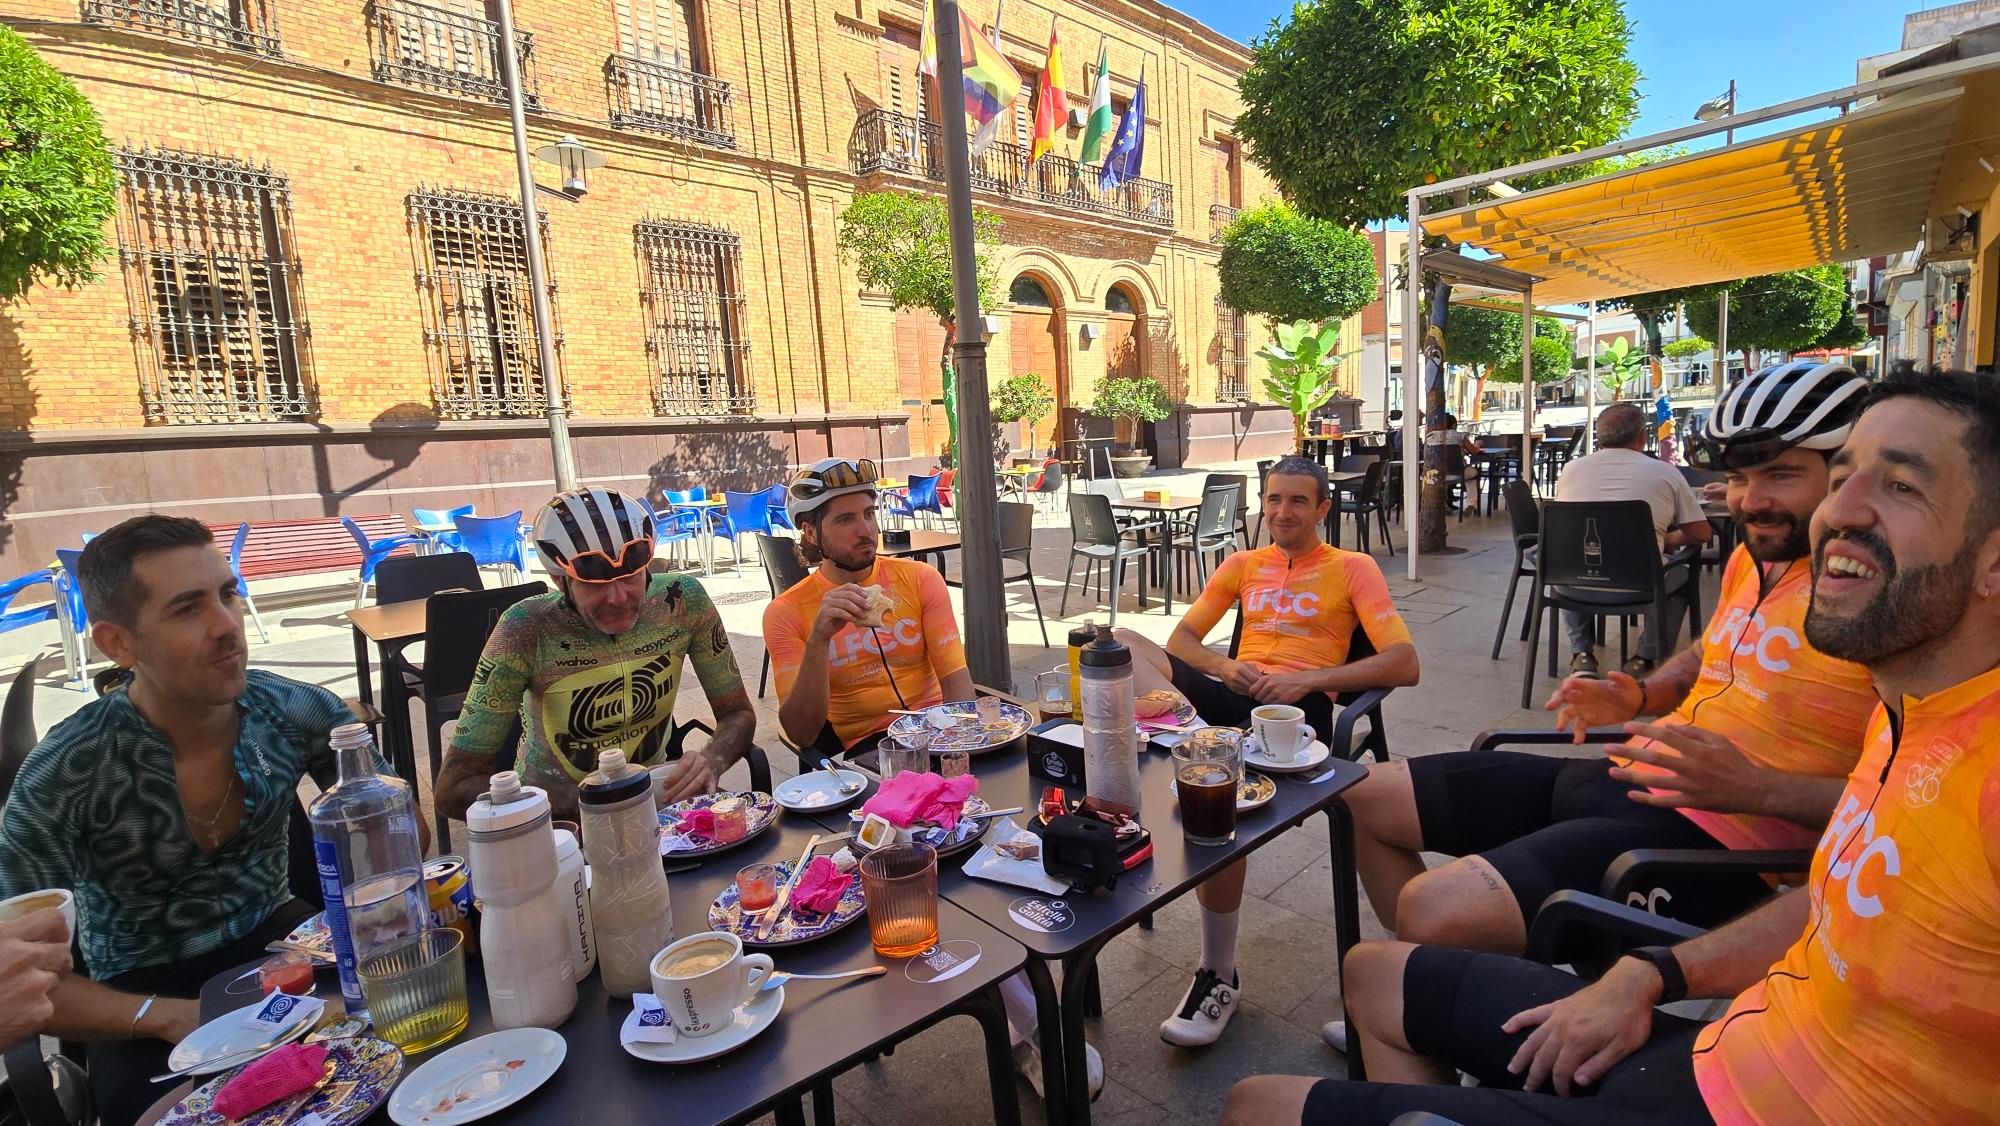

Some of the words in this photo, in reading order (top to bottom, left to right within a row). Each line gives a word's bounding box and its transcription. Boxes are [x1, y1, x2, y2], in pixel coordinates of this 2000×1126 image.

[1247, 588, 1320, 618] LFCC
[828, 618, 922, 667] LFCC
[555, 656, 599, 667] wahoo
[1018, 906, 1055, 928] Galicia
[1025, 899, 1067, 924] Estrella
